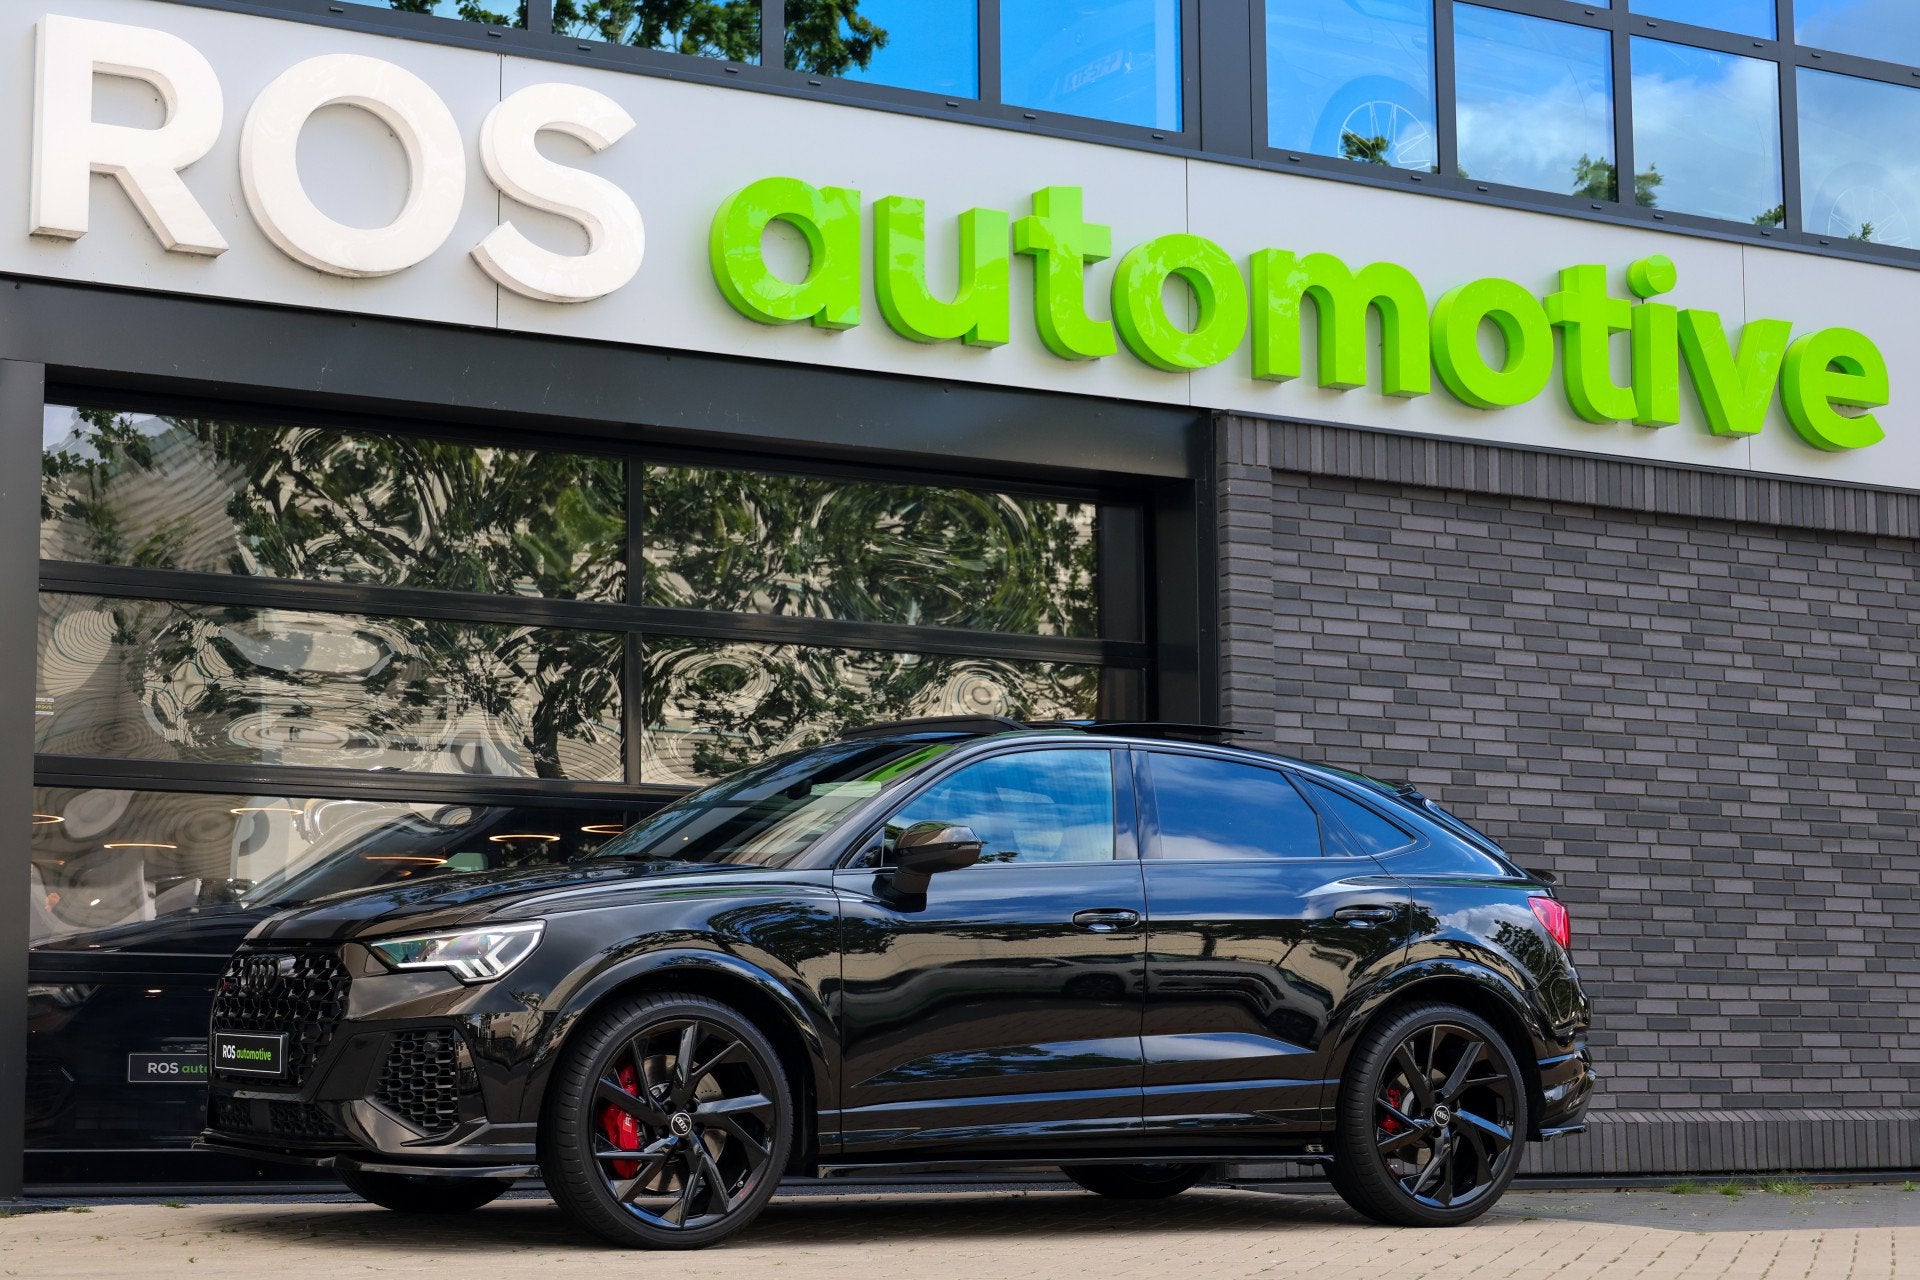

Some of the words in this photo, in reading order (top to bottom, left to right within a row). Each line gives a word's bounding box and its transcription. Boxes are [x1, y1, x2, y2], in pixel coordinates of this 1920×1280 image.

[29, 13, 646, 304] ROS
[709, 175, 1890, 453] automotive
[222, 1044, 236, 1059] ROS
[236, 1048, 272, 1061] automotive
[147, 1062, 179, 1074] ROS
